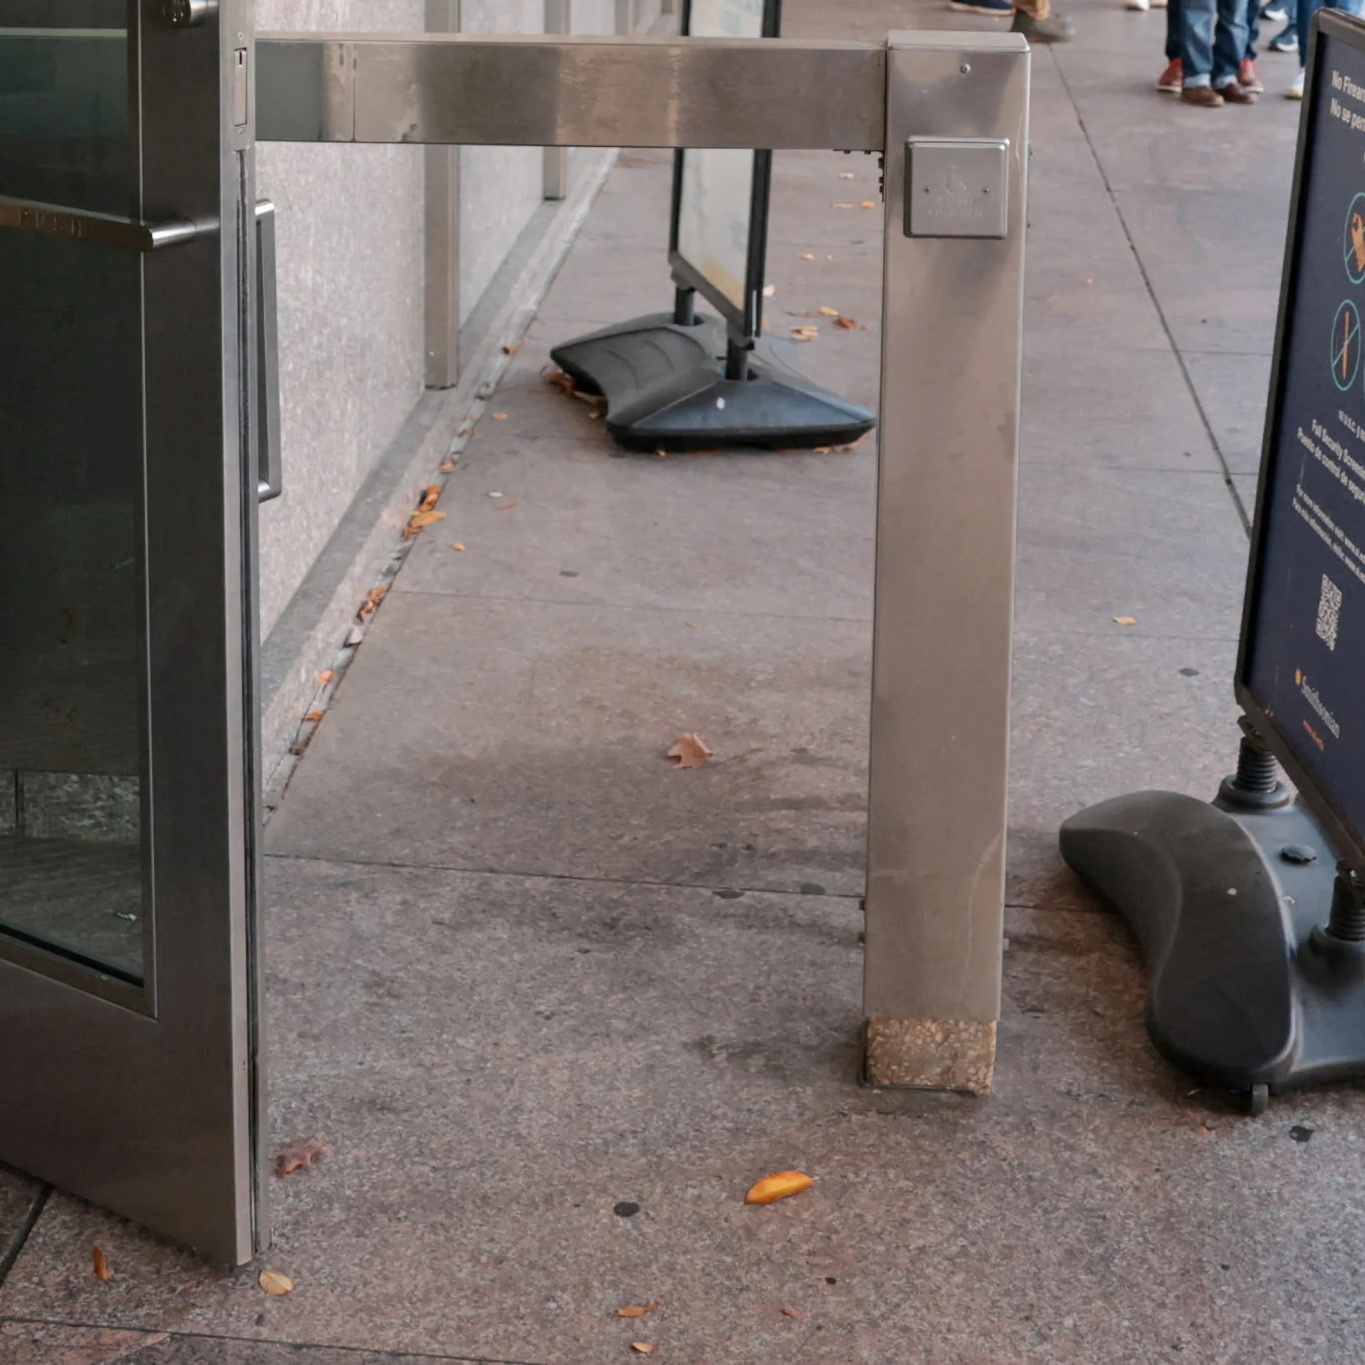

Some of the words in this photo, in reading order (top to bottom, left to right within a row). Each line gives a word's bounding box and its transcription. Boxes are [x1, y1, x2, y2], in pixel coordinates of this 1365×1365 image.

[1331, 70, 1343, 90] No
[1330, 97, 1341, 118] No
[1342, 107, 1351, 124] se
[1321, 428, 1343, 461] Security
[1301, 675, 1340, 739] Smithsonian
